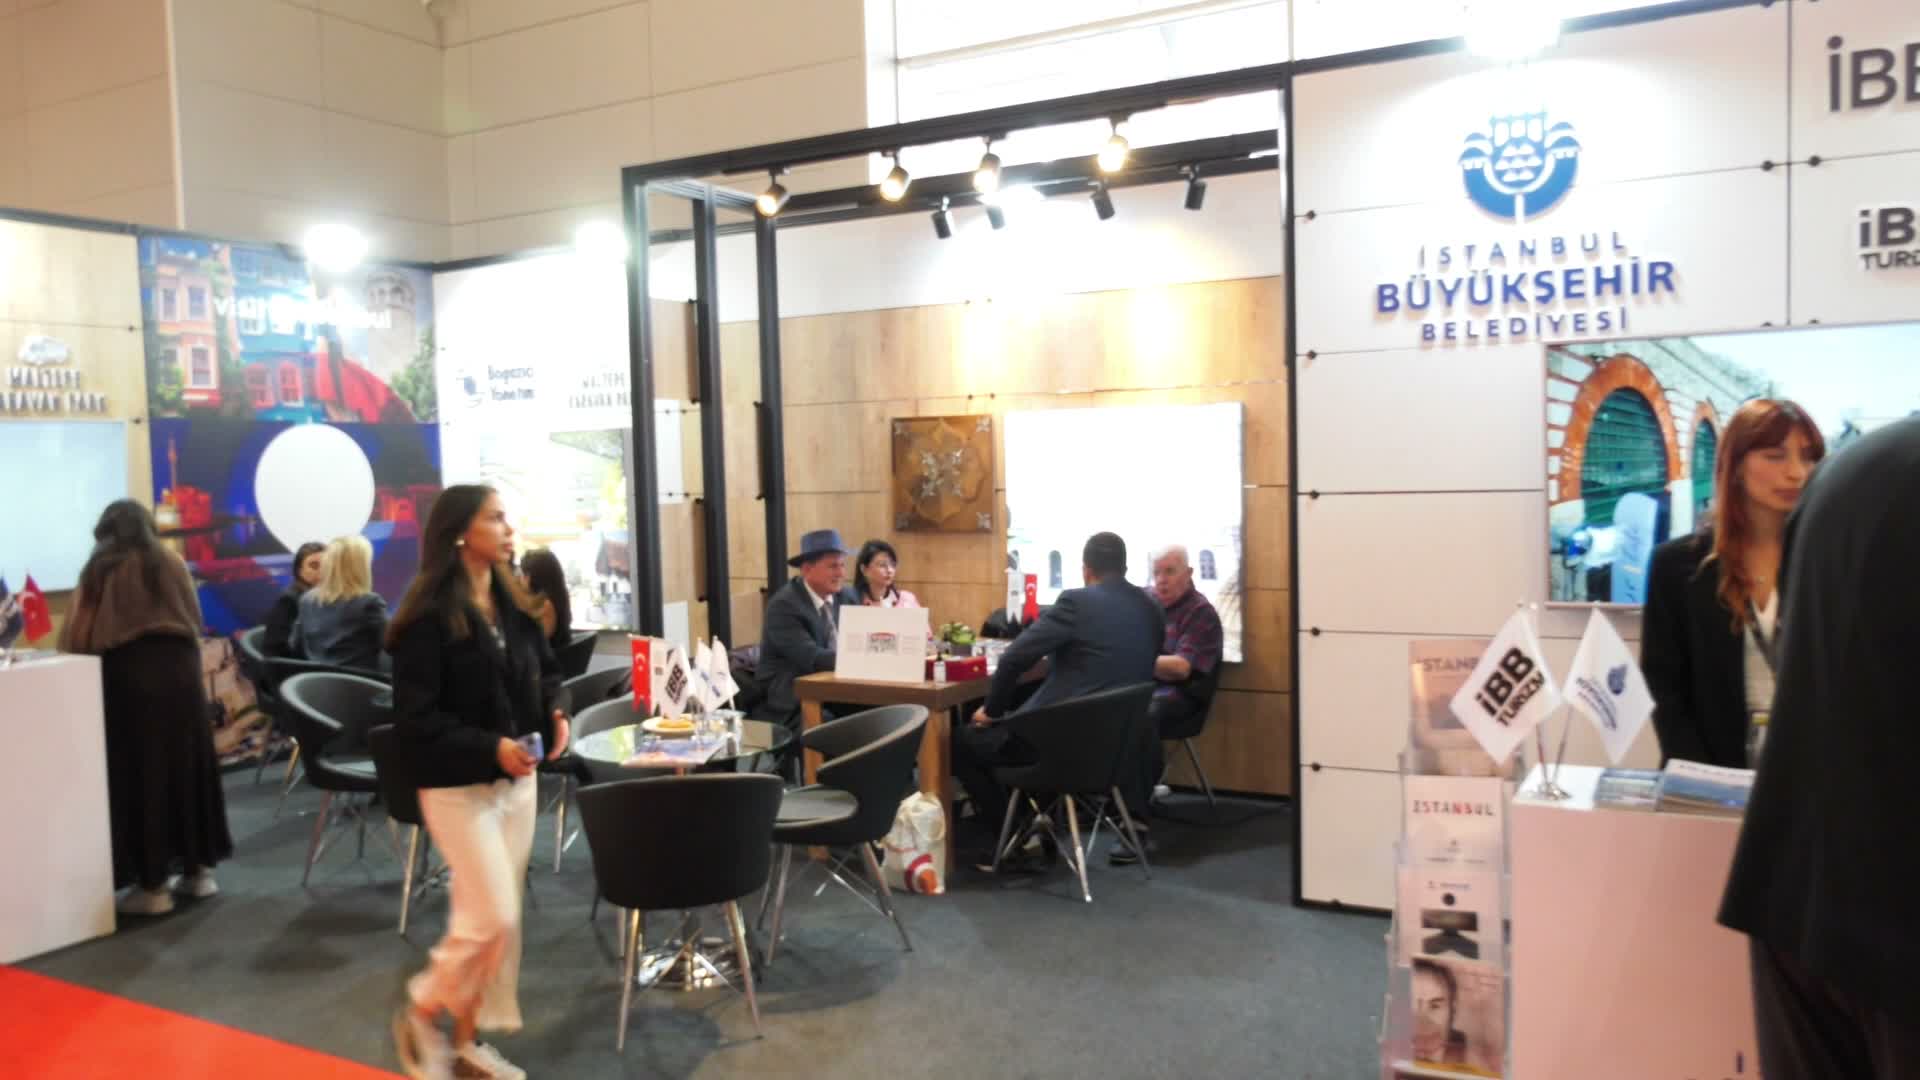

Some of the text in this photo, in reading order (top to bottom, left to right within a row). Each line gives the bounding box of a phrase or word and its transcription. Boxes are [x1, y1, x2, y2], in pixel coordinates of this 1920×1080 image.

[1418, 231, 1625, 267] İSTANBUL
[1376, 256, 1676, 313] BÜYÜKŞEHİR
[1422, 307, 1627, 342] BELEDİYESİ
